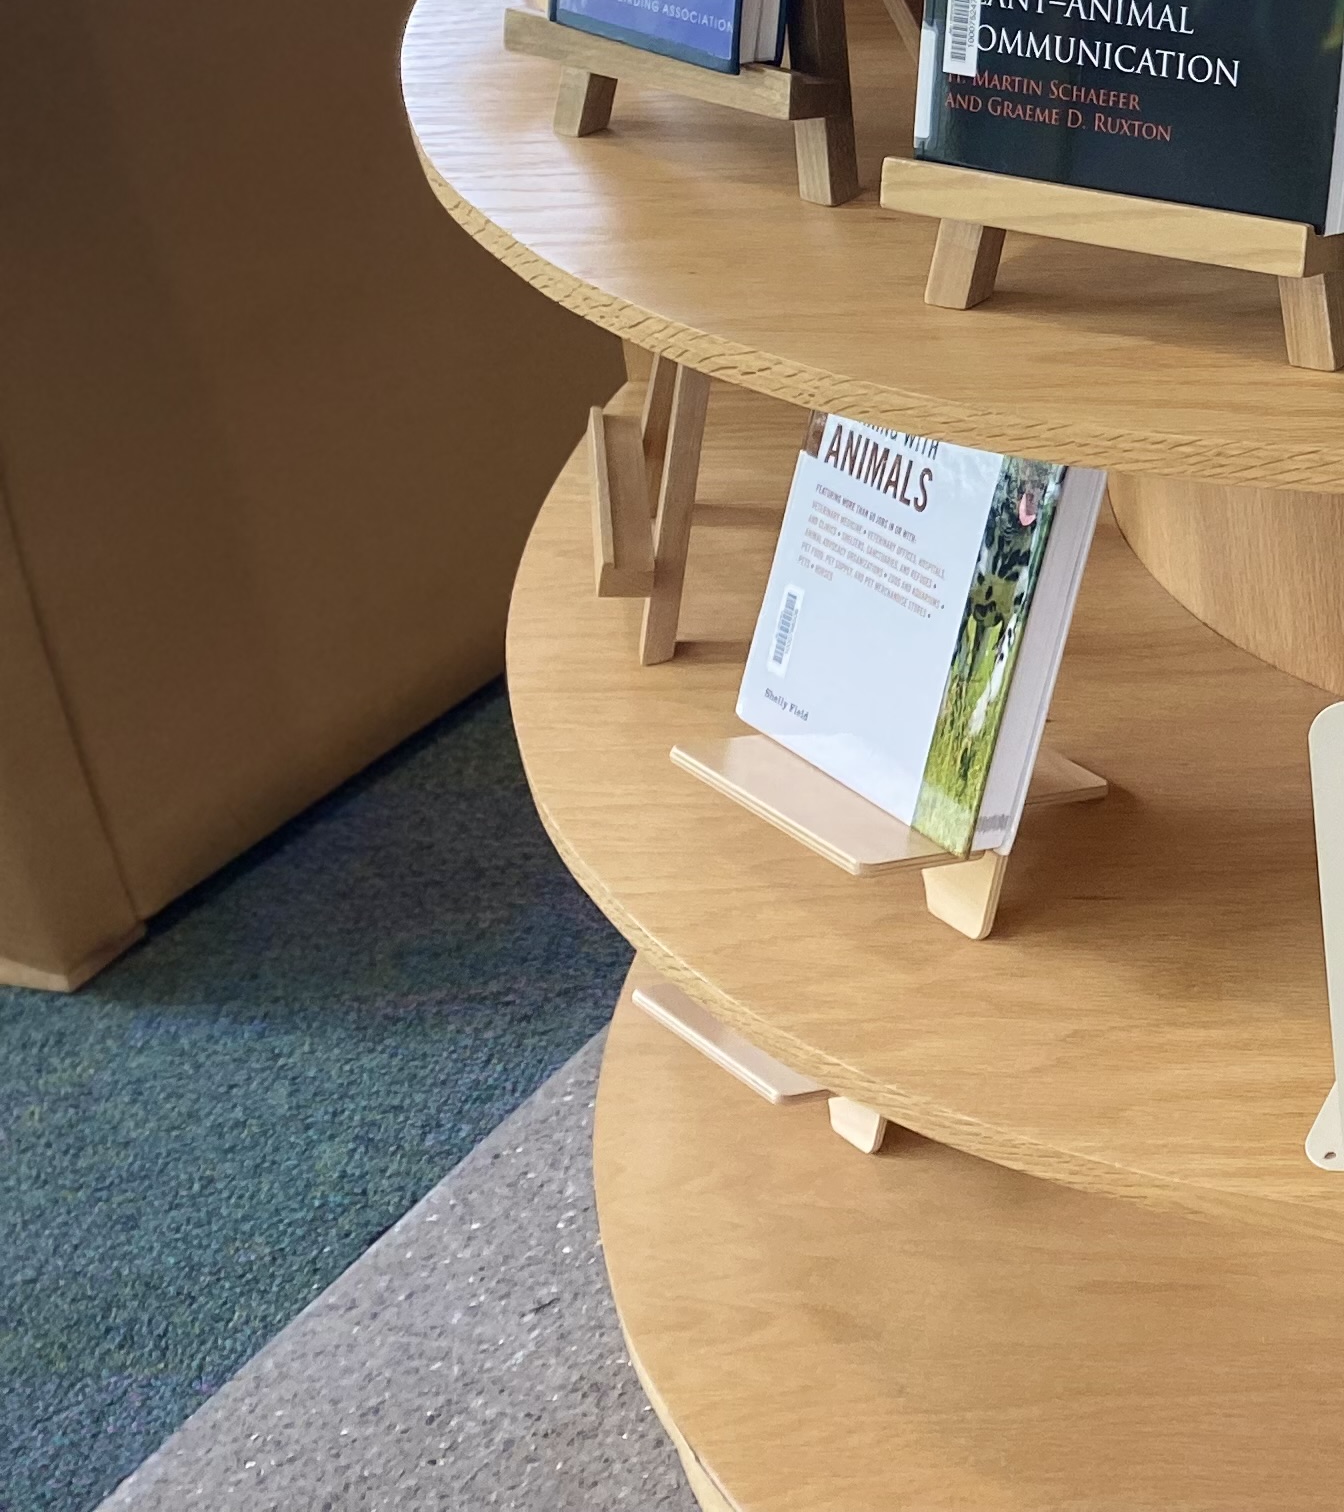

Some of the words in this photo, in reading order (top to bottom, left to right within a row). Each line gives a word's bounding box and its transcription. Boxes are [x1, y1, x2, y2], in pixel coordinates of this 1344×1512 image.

[977, 24, 1240, 87] OMMUNICATION
[944, 92, 982, 112] AND
[988, 97, 1060, 125] GRAEME
[1067, 109, 1086, 130] D.
[1094, 113, 1172, 142] RUXTON
[1049, 80, 1141, 111] SCHAEFER
[824, 423, 933, 513] ANIMALS
